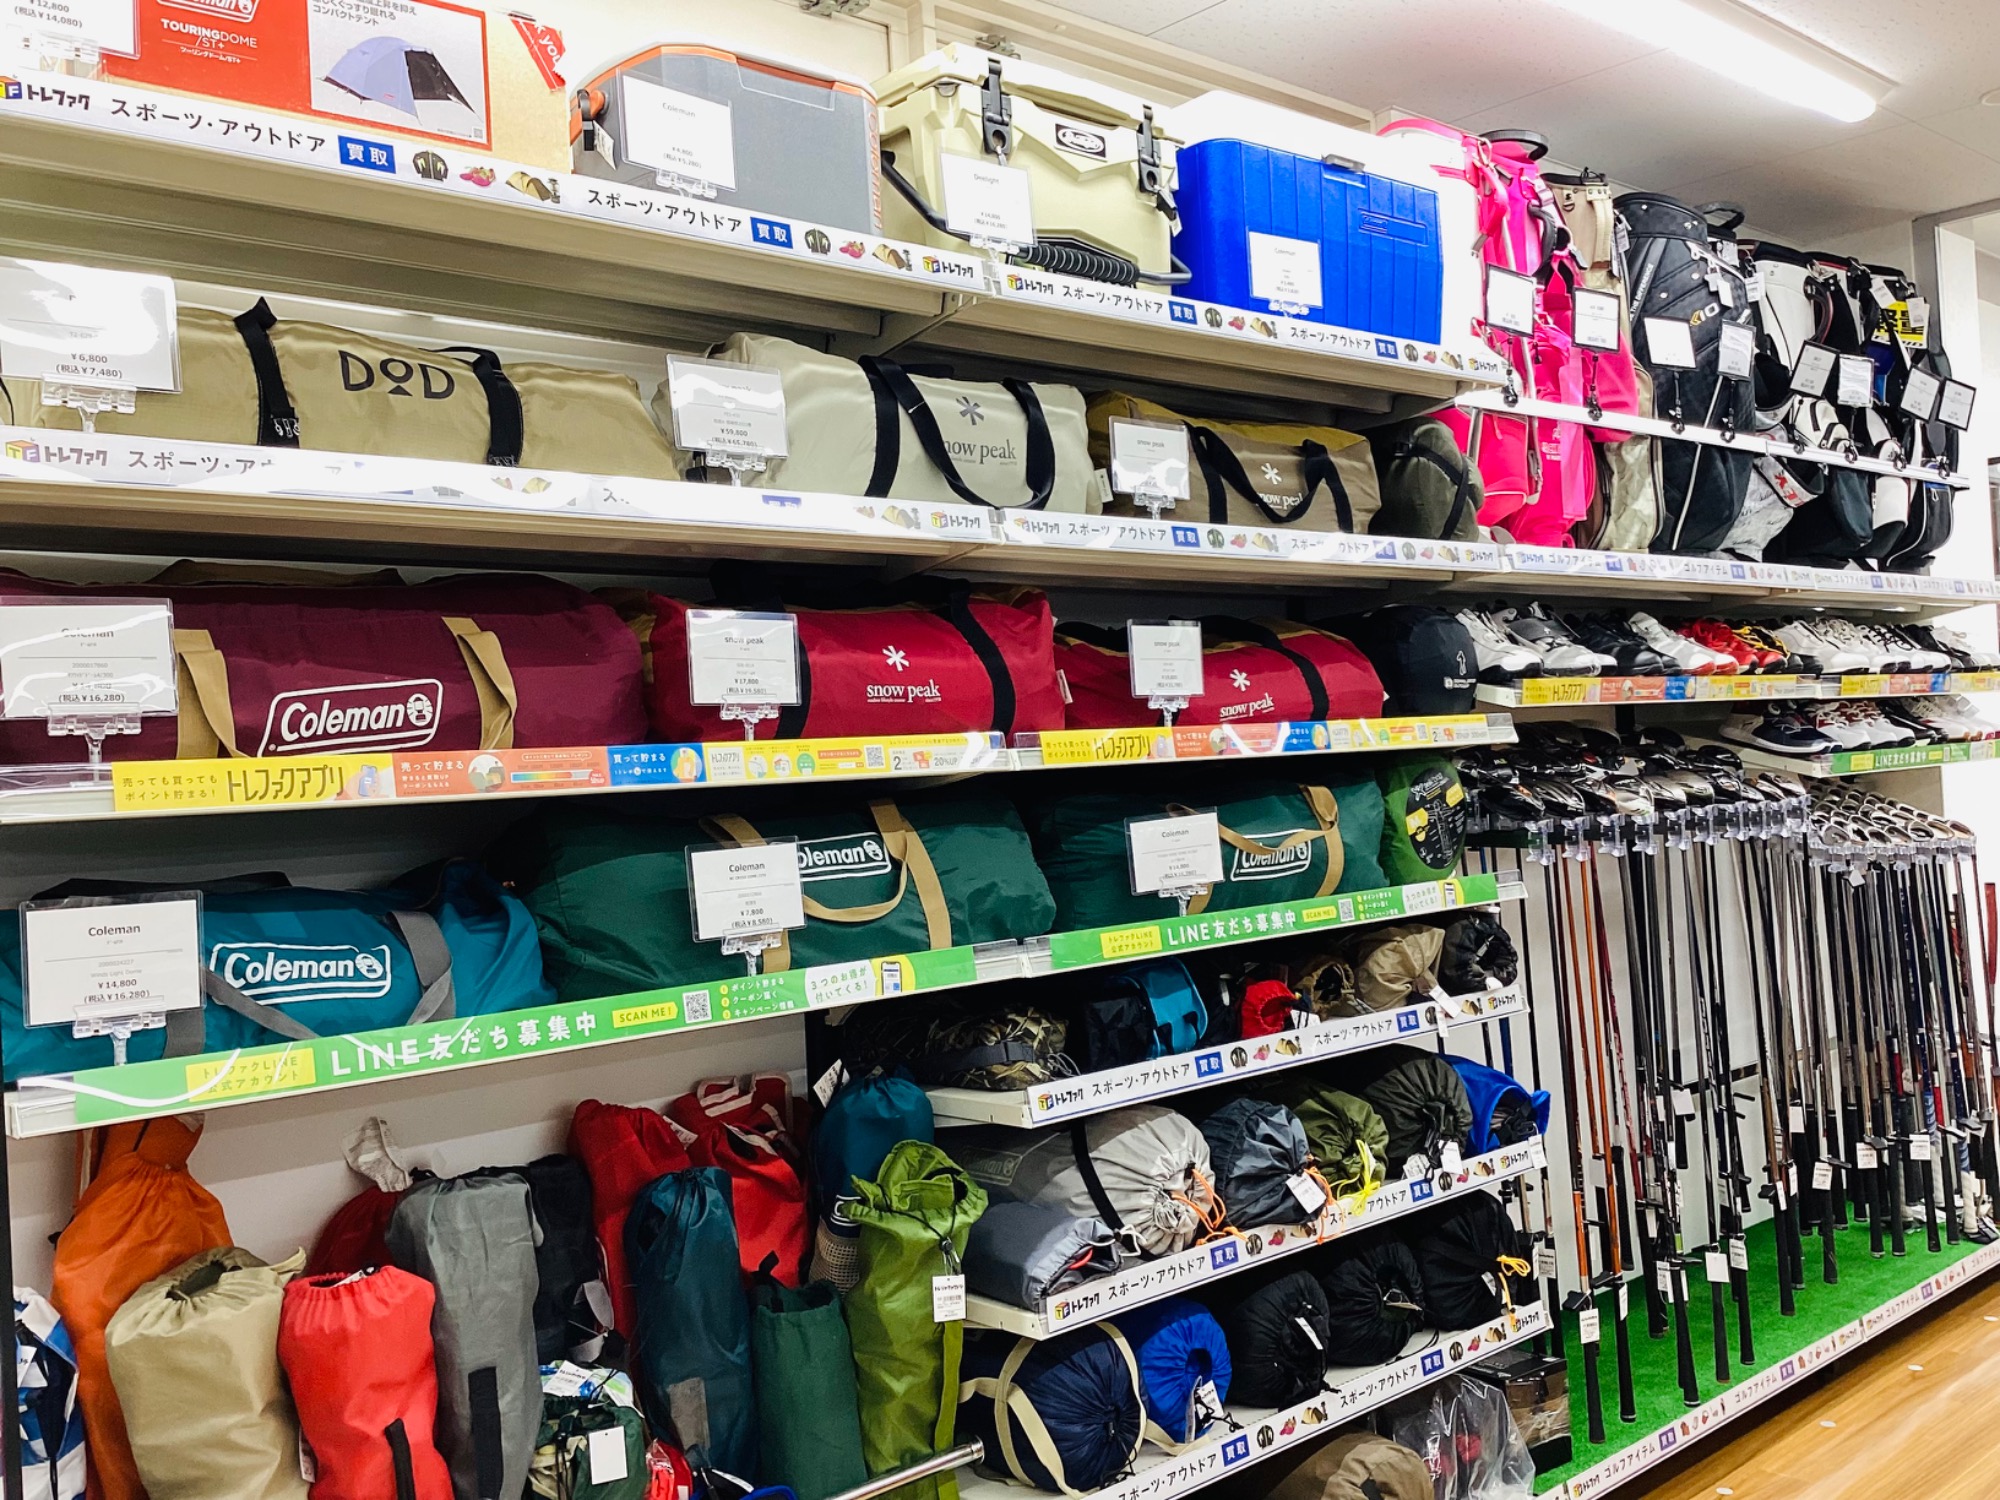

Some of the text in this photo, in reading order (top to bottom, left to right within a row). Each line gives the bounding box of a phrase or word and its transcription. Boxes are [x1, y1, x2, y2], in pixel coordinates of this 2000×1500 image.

[313, 4, 379, 26] コンパクトテント
[27, 84, 90, 110] トレファク
[111, 98, 325, 152] スポーツ・アウトドア
[347, 143, 389, 166] 買取
[588, 188, 742, 232] スポーツ・アウトドア
[756, 222, 788, 244] 買取
[942, 262, 974, 278] トレファク
[1024, 281, 1054, 295] トレファク
[1062, 284, 1164, 314] スポーツ・アウトドア
[1171, 304, 1194, 320] 買取
[1377, 341, 1397, 356] 買取
[71, 353, 108, 364] ¥6,800
[56, 363, 123, 379] (税込¥7,480)
[44, 446, 108, 466] トレファク
[944, 438, 1017, 464] now peak
[1259, 491, 1282, 504] now
[949, 516, 981, 529] トレファク
[1069, 522, 1167, 542] スポーツアウトドア
[1175, 531, 1197, 543] 買取
[1291, 538, 1369, 554] スポーウトドア
[866, 680, 941, 702] snow peak
[1220, 692, 1275, 717] snow peak
[281, 699, 406, 742] Coleman
[400, 761, 465, 773] 売って貯まる
[613, 752, 667, 765] 買って貯まる
[122, 775, 219, 788] 売っても買っても
[226, 763, 345, 804] トレファクアプリ
[1161, 829, 1190, 838] Coleman
[729, 863, 766, 872] Coleman
[799, 845, 865, 869] oleman
[88, 924, 141, 937] Coleman
[1167, 908, 1297, 946] LINE友だち募集中
[224, 951, 354, 988] Coleman
[97, 978, 137, 989] ¥14,800
[84, 989, 150, 1004] (税込¥16,280)
[619, 1007, 672, 1023] SCAN ME!
[331, 1011, 597, 1077] LINE友だち募集中
[1054, 1088, 1083, 1106] トレファク
[1092, 1063, 1190, 1097] スポーツ・アウトドア
[1199, 1058, 1220, 1073] 買取
[1314, 1019, 1393, 1046] スポーツ・アウトドア
[1399, 1015, 1417, 1029] 買取
[1330, 1189, 1408, 1227] スポーアウトドア
[1071, 1292, 1100, 1314] トレファク
[1108, 1255, 1206, 1301] スポーツ・アウトドア
[1213, 1246, 1236, 1265] 買取
[1339, 1364, 1417, 1409] スポーツ・アウトドア
[1423, 1354, 1442, 1371] 買取
[1603, 1444, 1655, 1479] ゴルフアイテム
[1734, 1374, 1778, 1404] ゴルフアイテム
[1225, 1445, 1247, 1462] 買取
